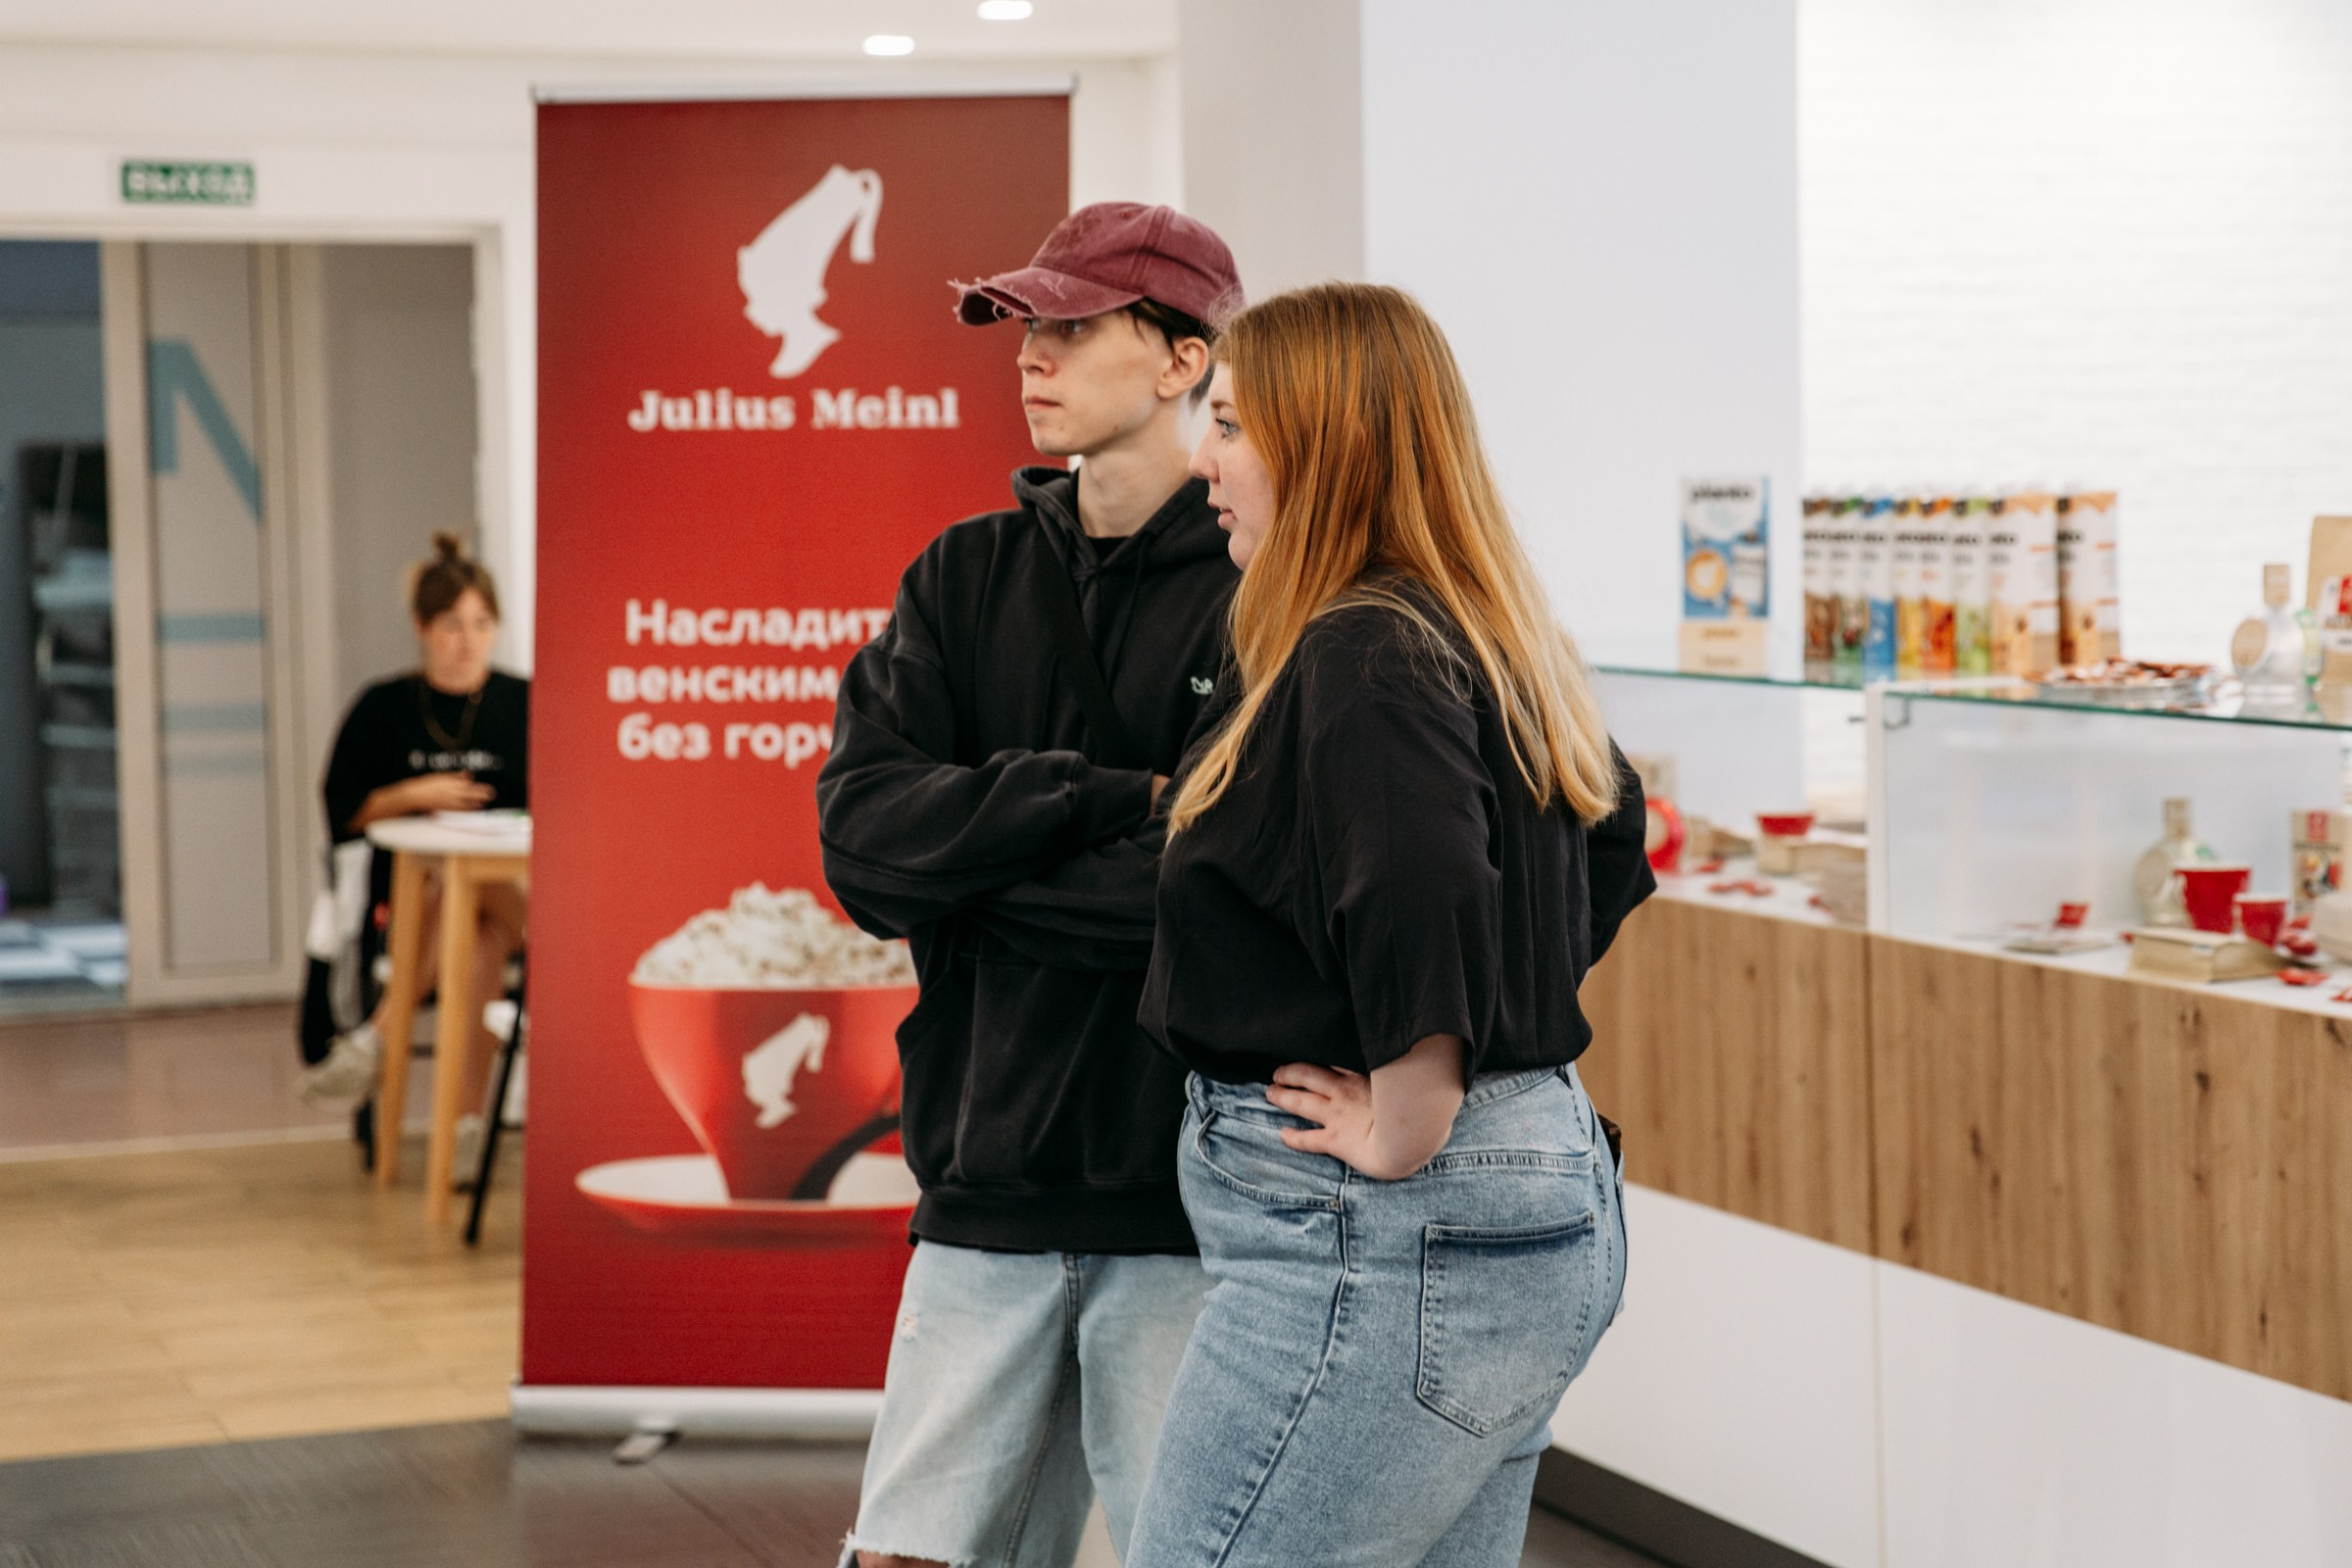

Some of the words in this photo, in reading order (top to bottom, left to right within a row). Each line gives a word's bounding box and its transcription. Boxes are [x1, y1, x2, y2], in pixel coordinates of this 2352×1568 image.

[626, 388, 797, 432] Julius
[810, 384, 961, 430] Meinl
[624, 597, 895, 652] Насладит
[606, 663, 840, 705] венским
[616, 710, 712, 761] без
